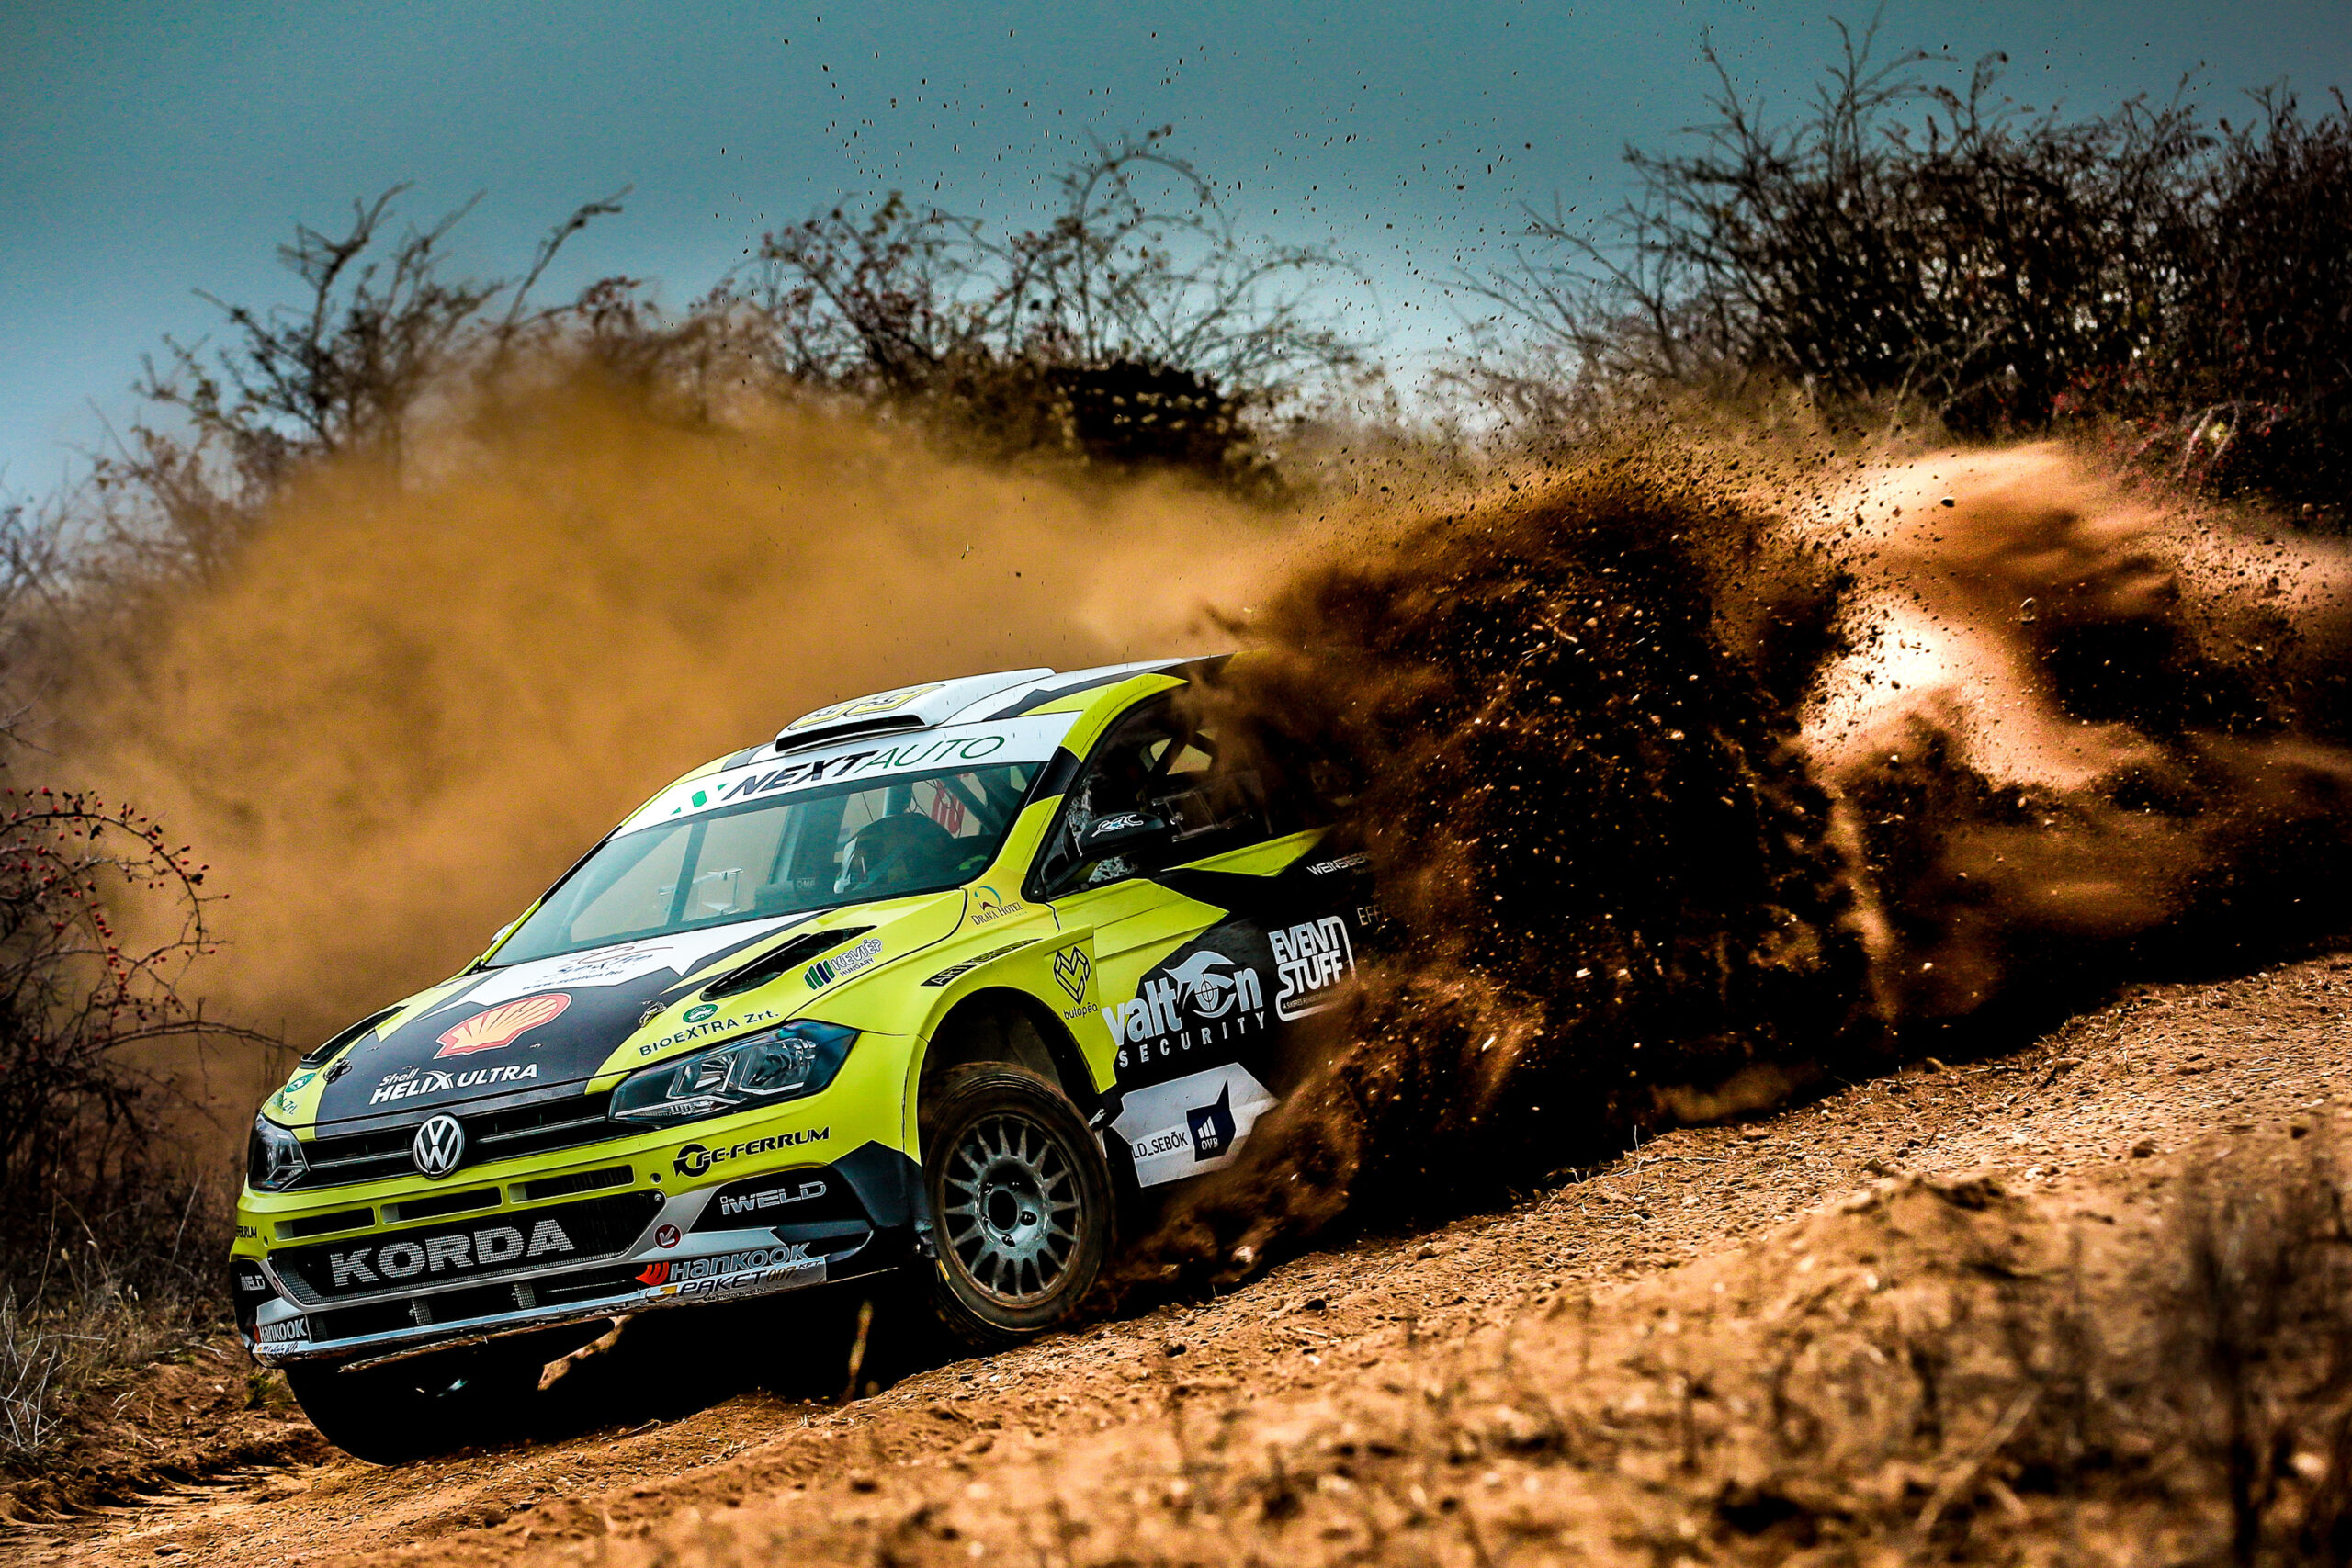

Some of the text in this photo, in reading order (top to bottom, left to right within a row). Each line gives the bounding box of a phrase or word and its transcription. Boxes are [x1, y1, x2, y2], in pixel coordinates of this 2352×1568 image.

[721, 735, 1005, 801] NEXTAUTO
[1268, 917, 1342, 964] EVENT
[840, 958, 875, 976] HUNGARY
[1278, 950, 1343, 995] STUFF
[639, 1018, 739, 1056] BIOEXTRA
[745, 1010, 779, 1024] Zrt.
[1118, 1011, 1265, 1066] SECURITY
[368, 1063, 538, 1105] HELIX ULTRA
[379, 1067, 419, 1087] Shell
[329, 1218, 575, 1287] KORDA
[679, 1269, 767, 1297] PAKET
[766, 1266, 797, 1283] 007
